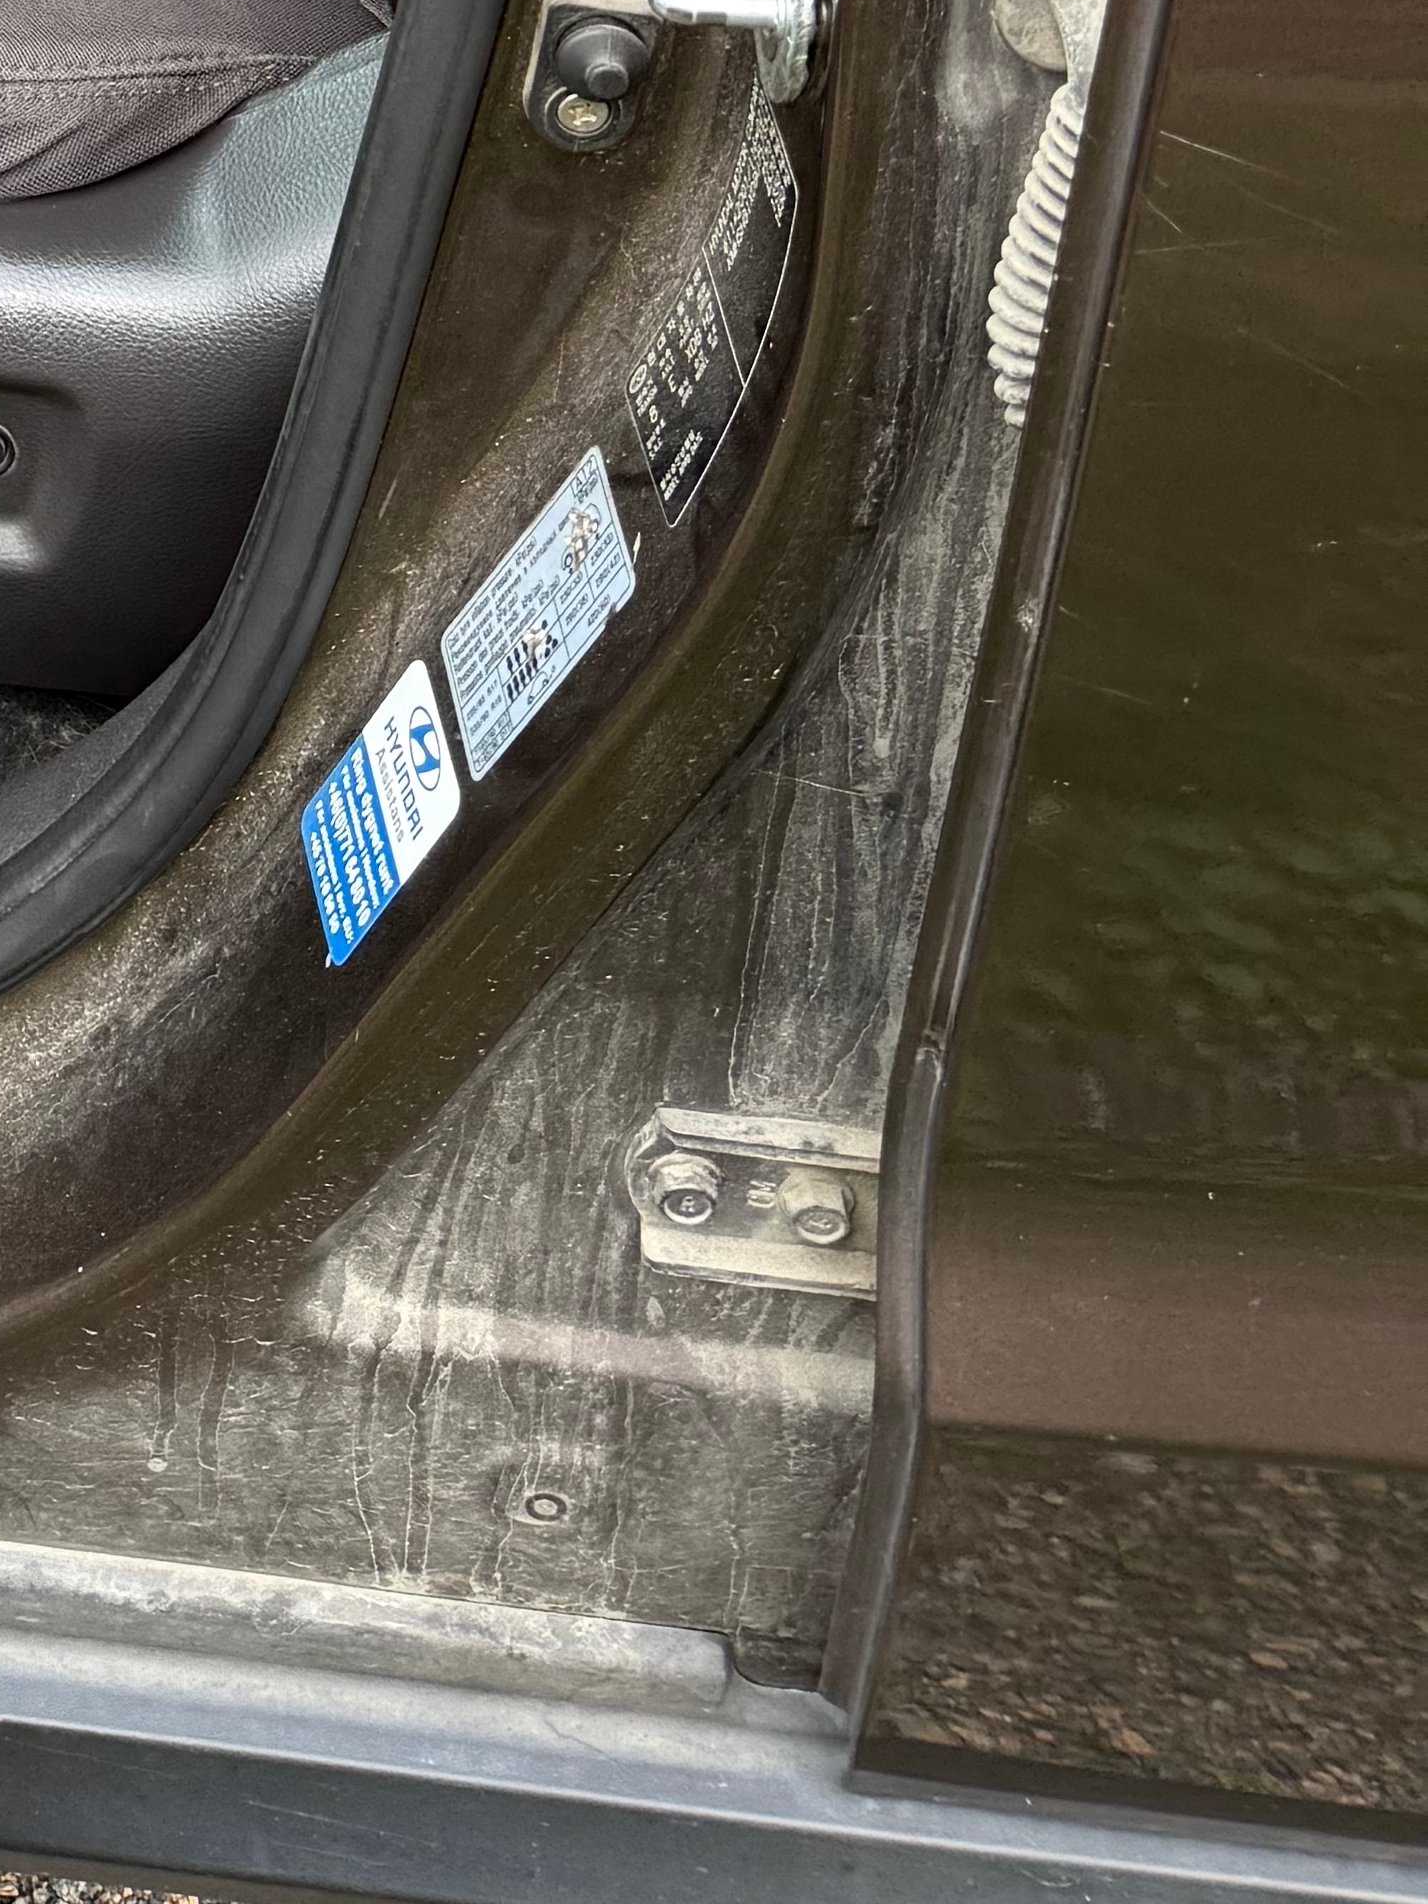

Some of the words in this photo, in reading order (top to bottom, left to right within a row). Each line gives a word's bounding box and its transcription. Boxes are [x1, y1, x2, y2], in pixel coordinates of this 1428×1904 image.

[347, 744, 370, 798] Ring
[374, 743, 407, 845] Assistans
[382, 714, 424, 842] HYUNDAI
[358, 787, 385, 859] dygnet
[375, 848, 394, 896] runt
